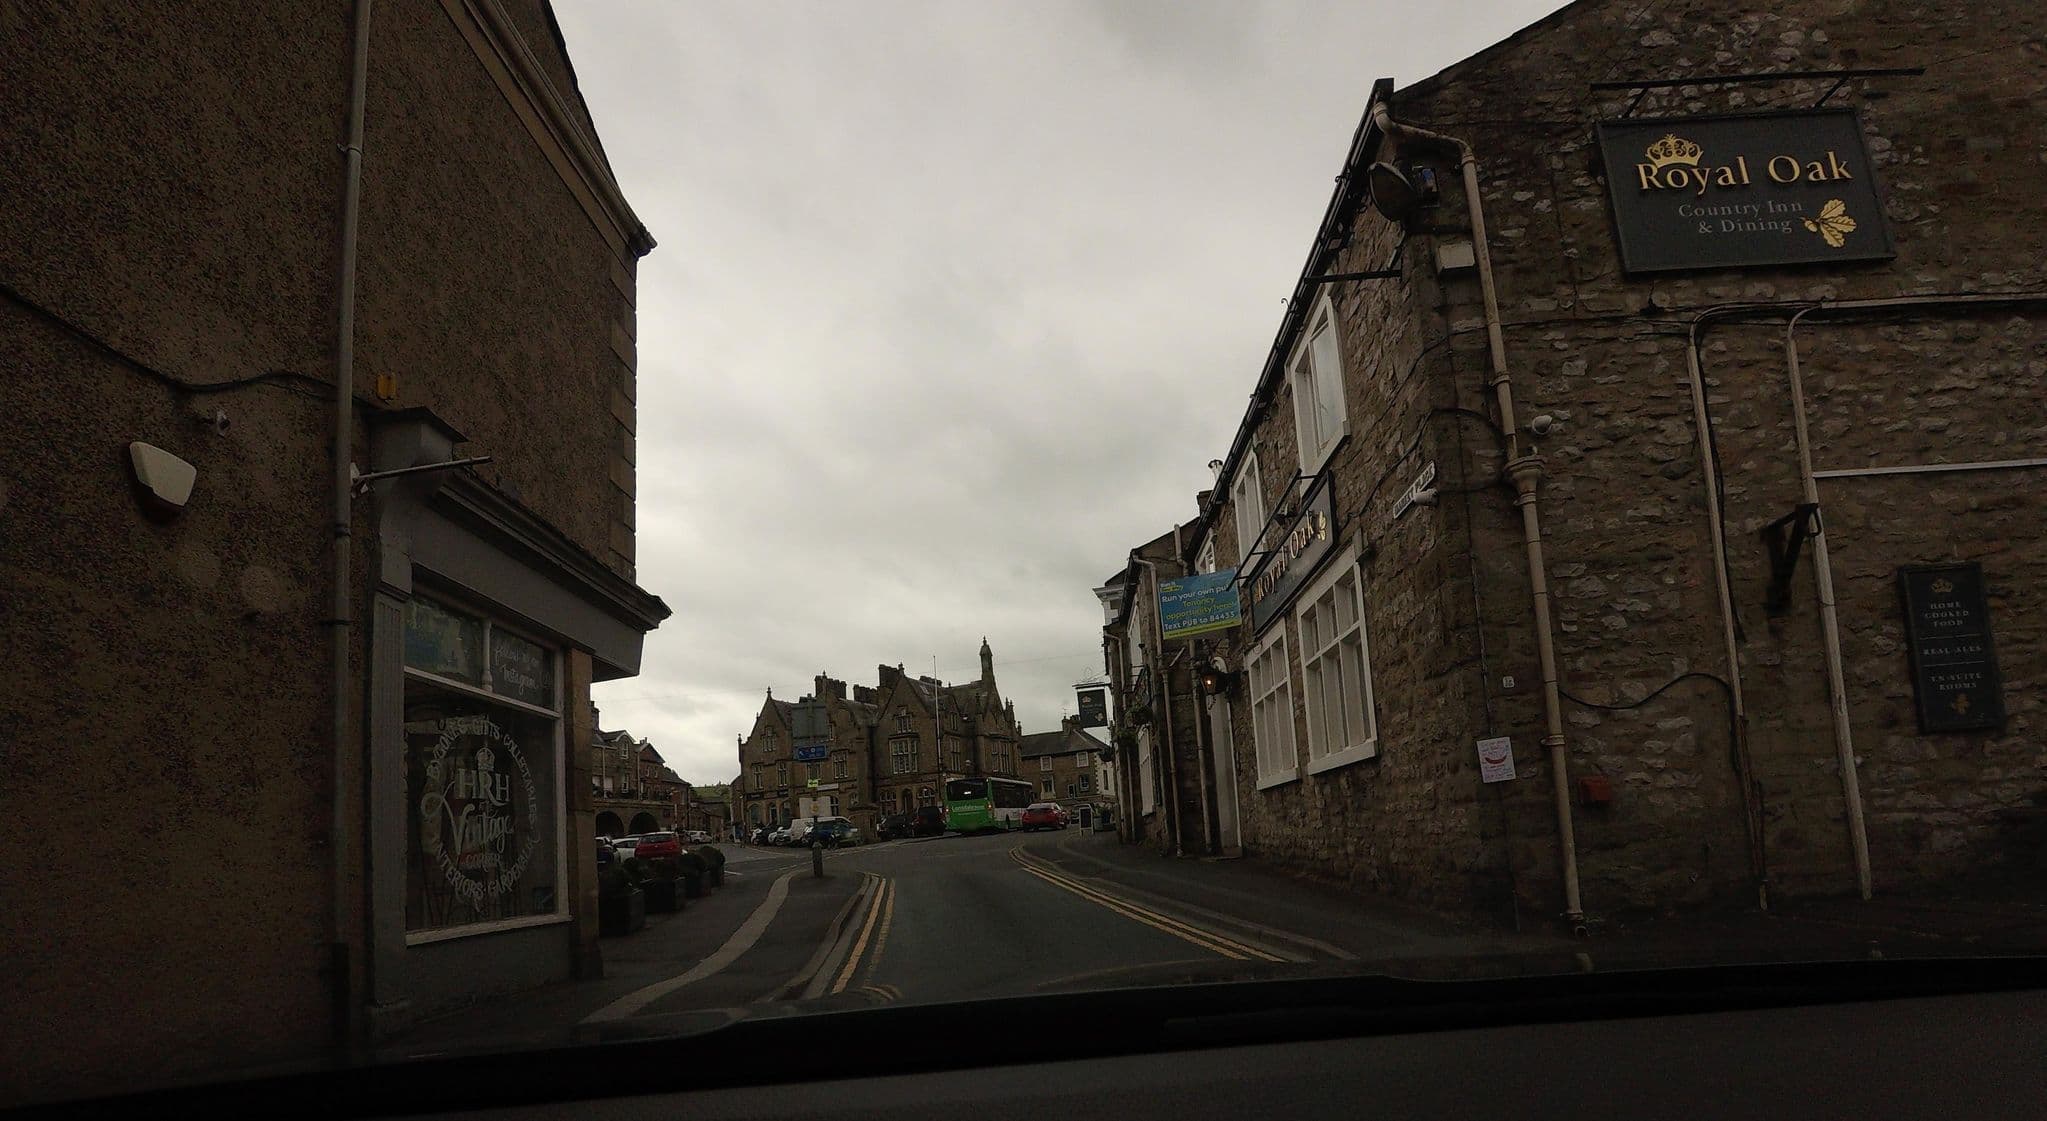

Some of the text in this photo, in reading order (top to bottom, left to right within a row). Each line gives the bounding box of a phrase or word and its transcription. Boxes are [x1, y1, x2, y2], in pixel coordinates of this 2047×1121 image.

[1635, 151, 1853, 195] Royal Oak
[1678, 200, 1803, 219] Country Inn
[1697, 218, 1792, 234] & Dining
[1256, 510, 1315, 602] Royal Oak
[1178, 592, 1196, 601] your
[1930, 601, 1961, 610] HOME
[1924, 610, 1969, 619] COOKED
[1164, 622, 1181, 630] Text
[1182, 618, 1198, 627] PUB
[1933, 619, 1963, 628] FOOD
[1923, 645, 1982, 656] REAL ALES
[1939, 682, 1977, 691] ROOMS
[453, 767, 511, 808] HRH
[420, 788, 514, 855] Vintage
